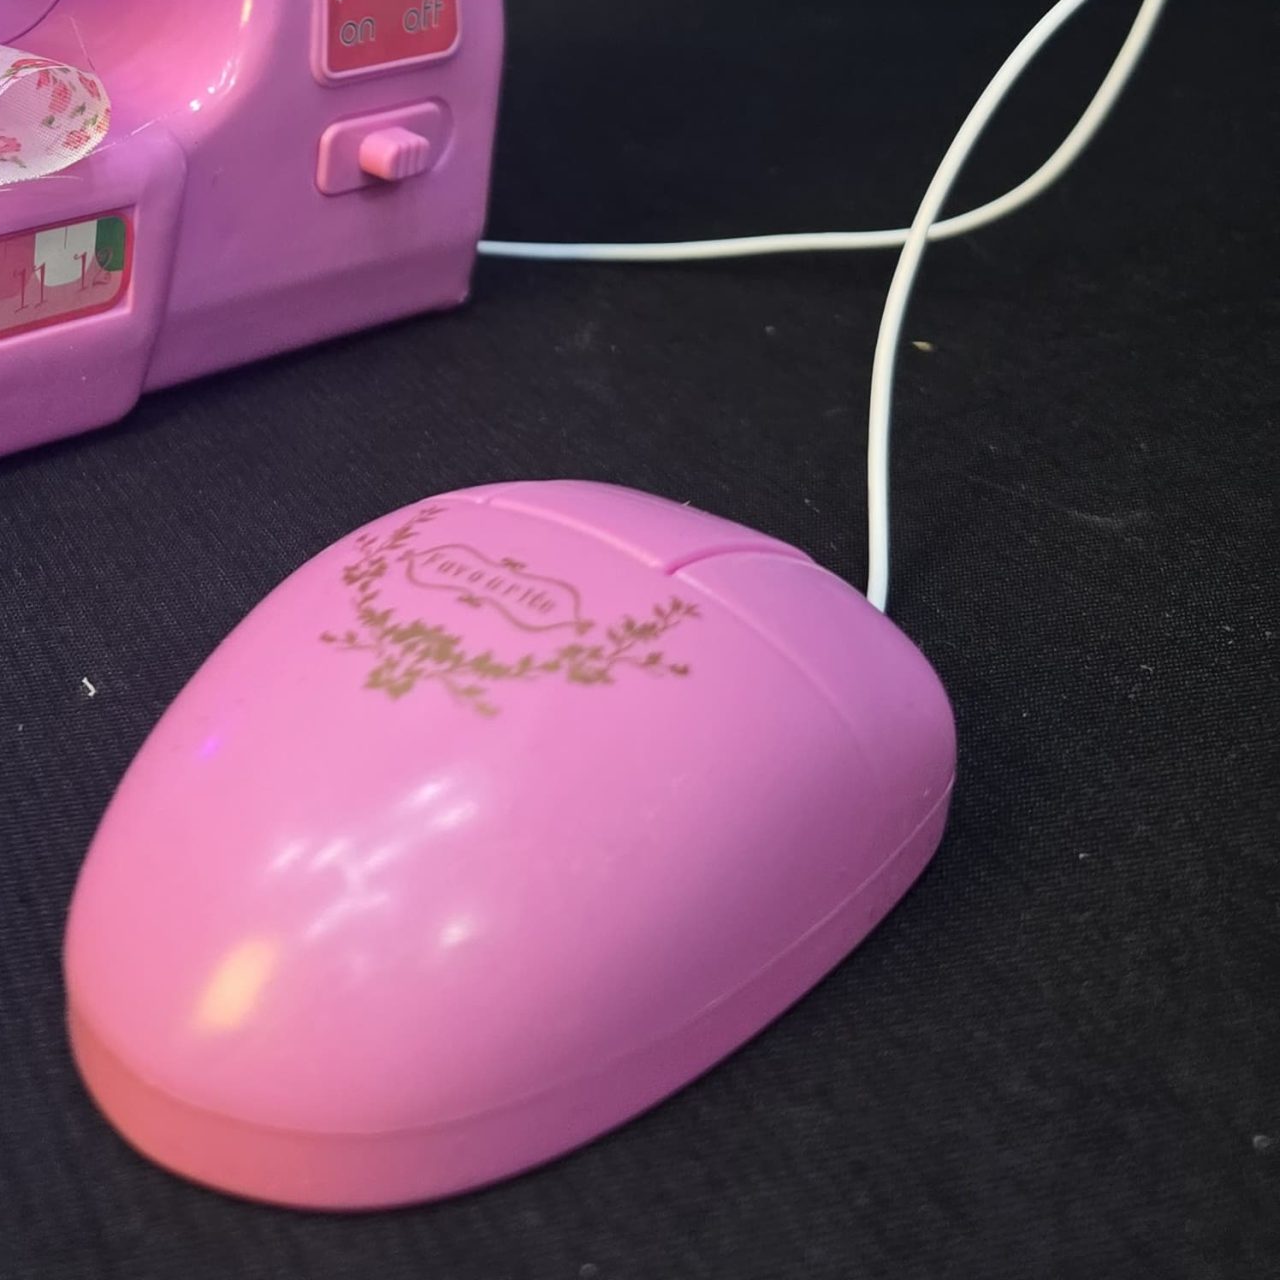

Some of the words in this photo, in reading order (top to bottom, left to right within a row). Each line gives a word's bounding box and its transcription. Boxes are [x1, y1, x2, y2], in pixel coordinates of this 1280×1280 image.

[339, 17, 376, 47] on
[12, 262, 49, 314] 11
[73, 246, 113, 295] 12
